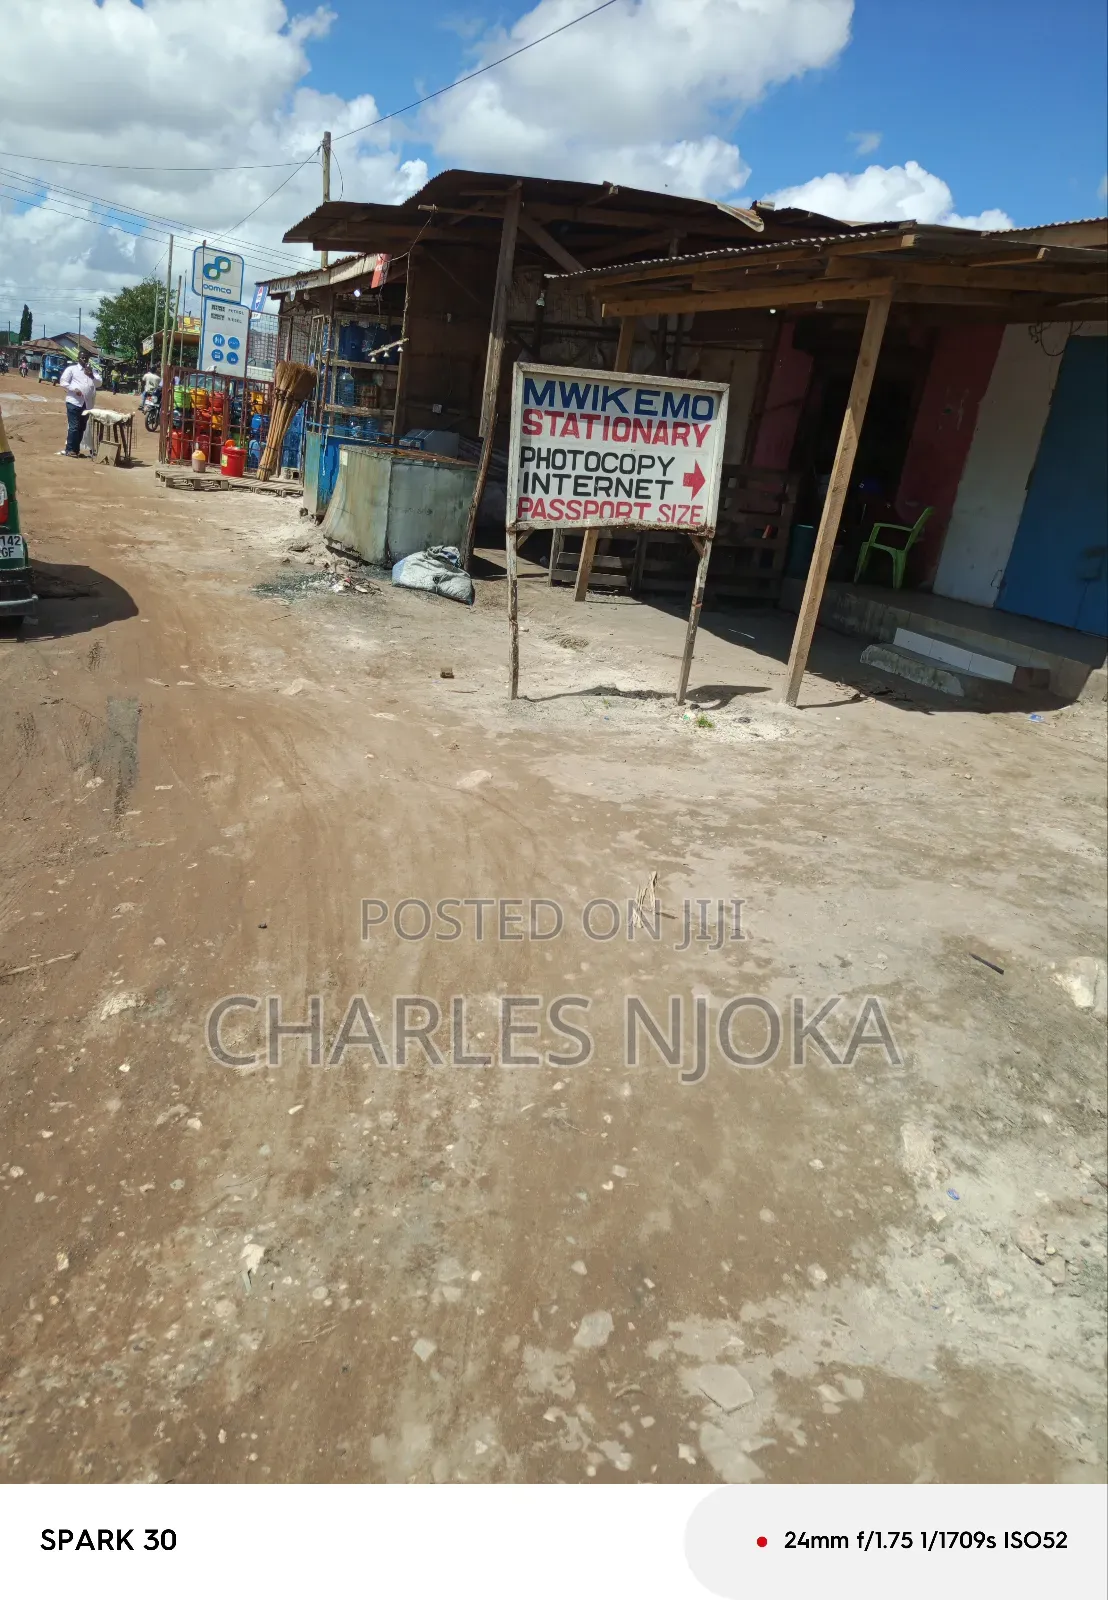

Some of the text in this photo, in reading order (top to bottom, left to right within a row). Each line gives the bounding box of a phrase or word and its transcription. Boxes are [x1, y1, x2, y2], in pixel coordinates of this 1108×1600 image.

[523, 377, 714, 421] MWIKEMO
[521, 408, 712, 448] STATIONARY
[519, 446, 676, 477] PHOTOCOPY
[522, 471, 674, 500] INTERNET
[517, 497, 704, 526] PASSPORT SIZE
[0, 546, 15, 558] GF
